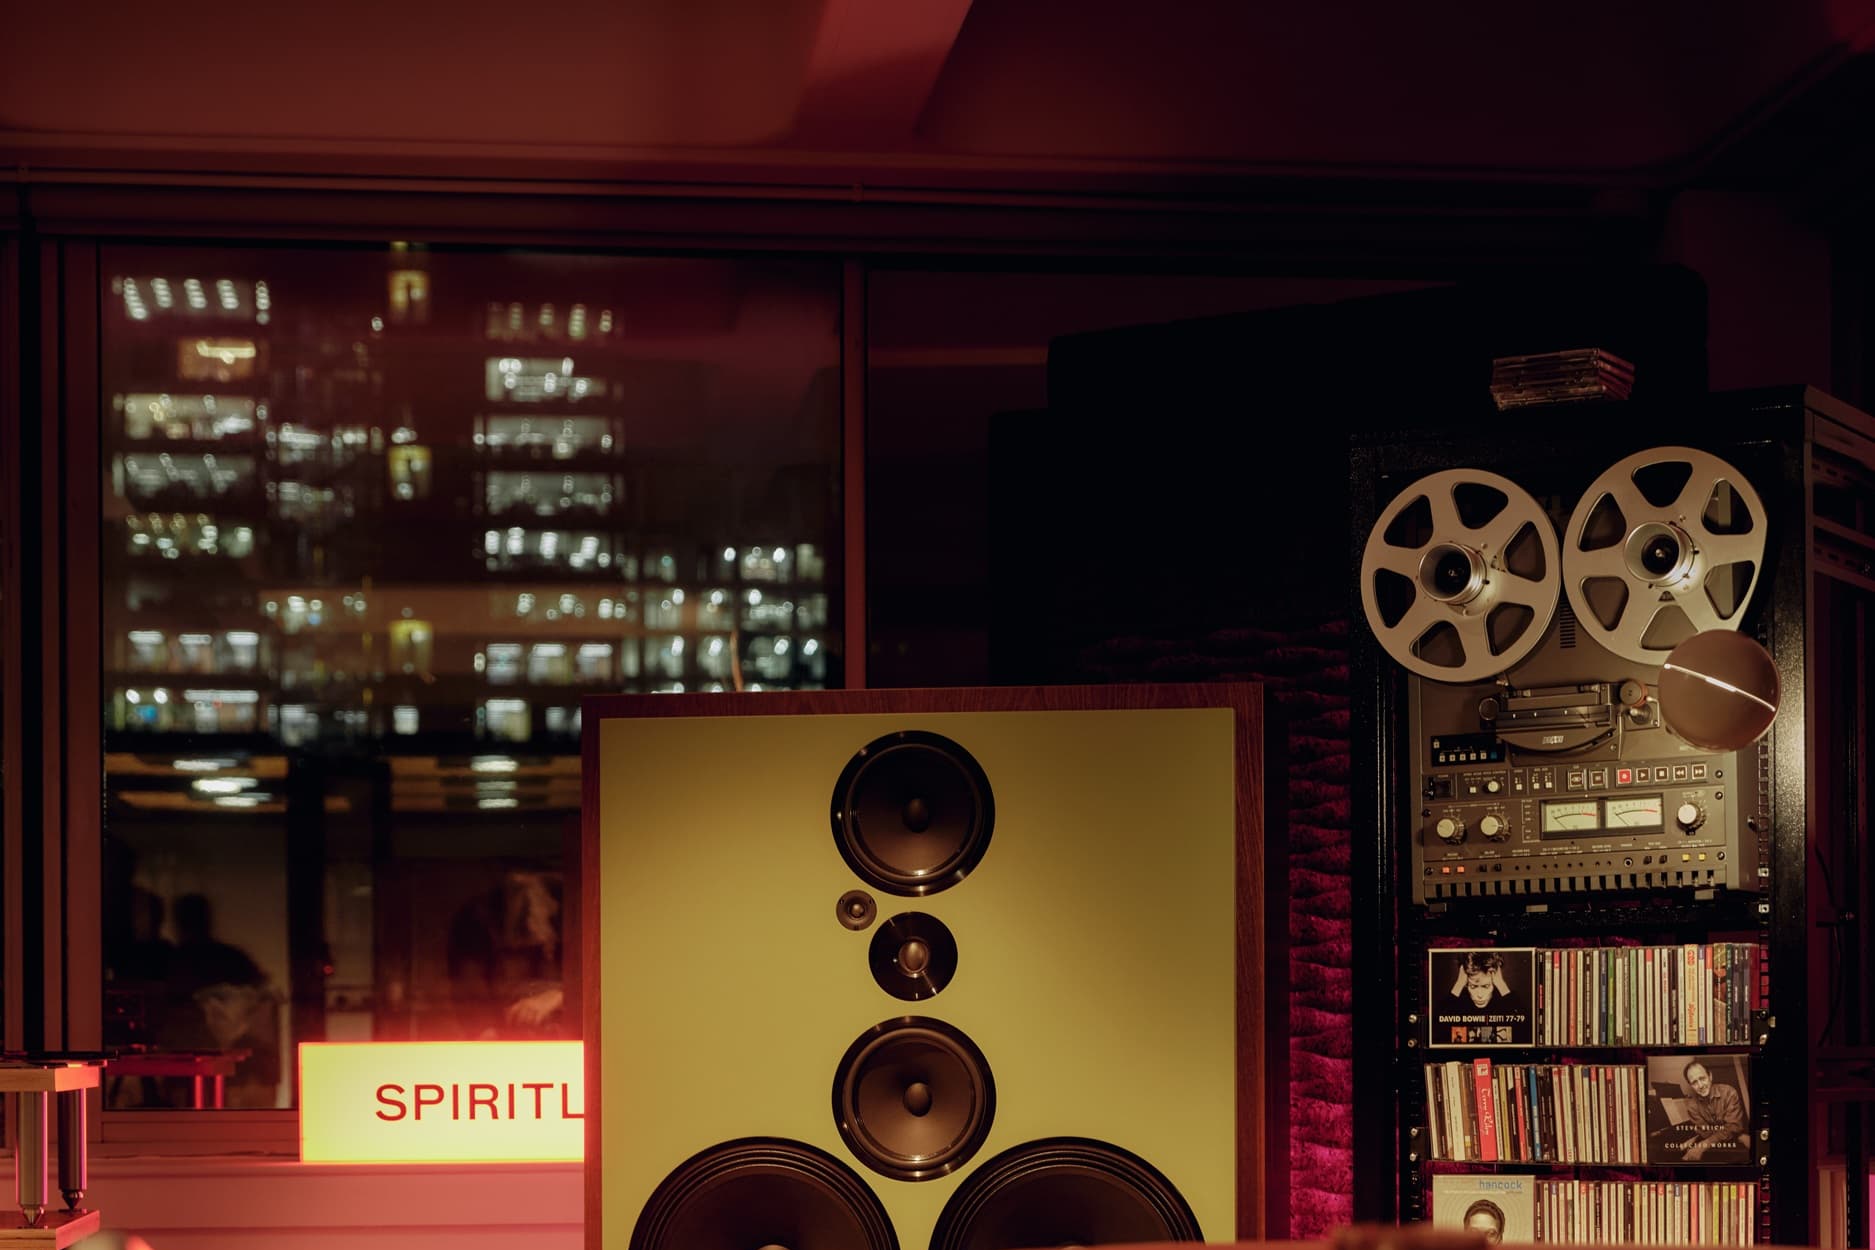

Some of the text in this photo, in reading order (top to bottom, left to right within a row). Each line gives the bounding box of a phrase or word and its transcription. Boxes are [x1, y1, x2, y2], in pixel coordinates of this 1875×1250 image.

[1439, 1015, 1461, 1023] DAVID
[1462, 1015, 1486, 1023] BOWIE
[1479, 1179, 1523, 1190] hancock
